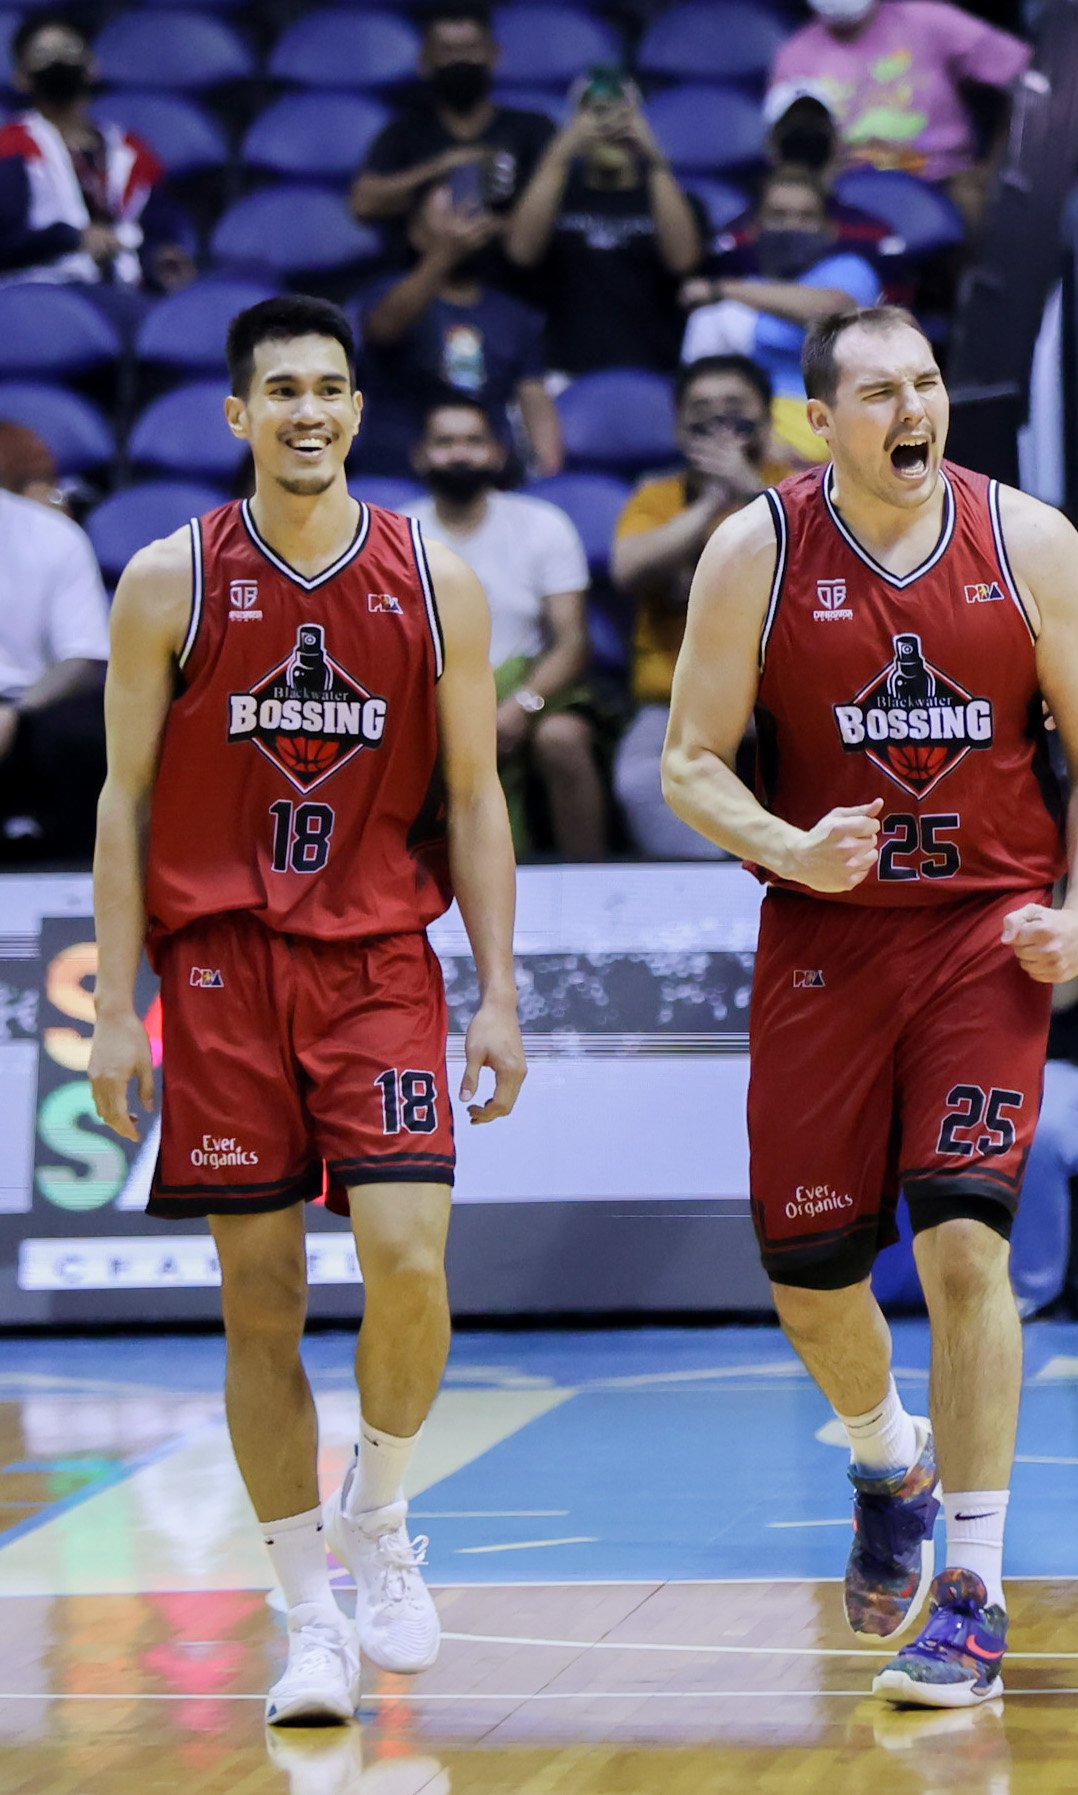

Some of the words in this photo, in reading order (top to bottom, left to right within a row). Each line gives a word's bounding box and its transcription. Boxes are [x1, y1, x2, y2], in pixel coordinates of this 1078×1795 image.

[964, 581, 1005, 604] PBA
[229, 695, 387, 741] BOSSING
[835, 700, 992, 744] BOSSING
[269, 799, 335, 874] 18
[878, 813, 961, 881] 25
[190, 967, 224, 988] PBA
[374, 1068, 438, 1135] 18
[936, 1084, 1024, 1157] 25
[191, 1147, 258, 1169] Organics
[203, 1135, 236, 1151] Ever
[785, 1191, 853, 1219] Organics
[795, 1184, 829, 1201] Ever
